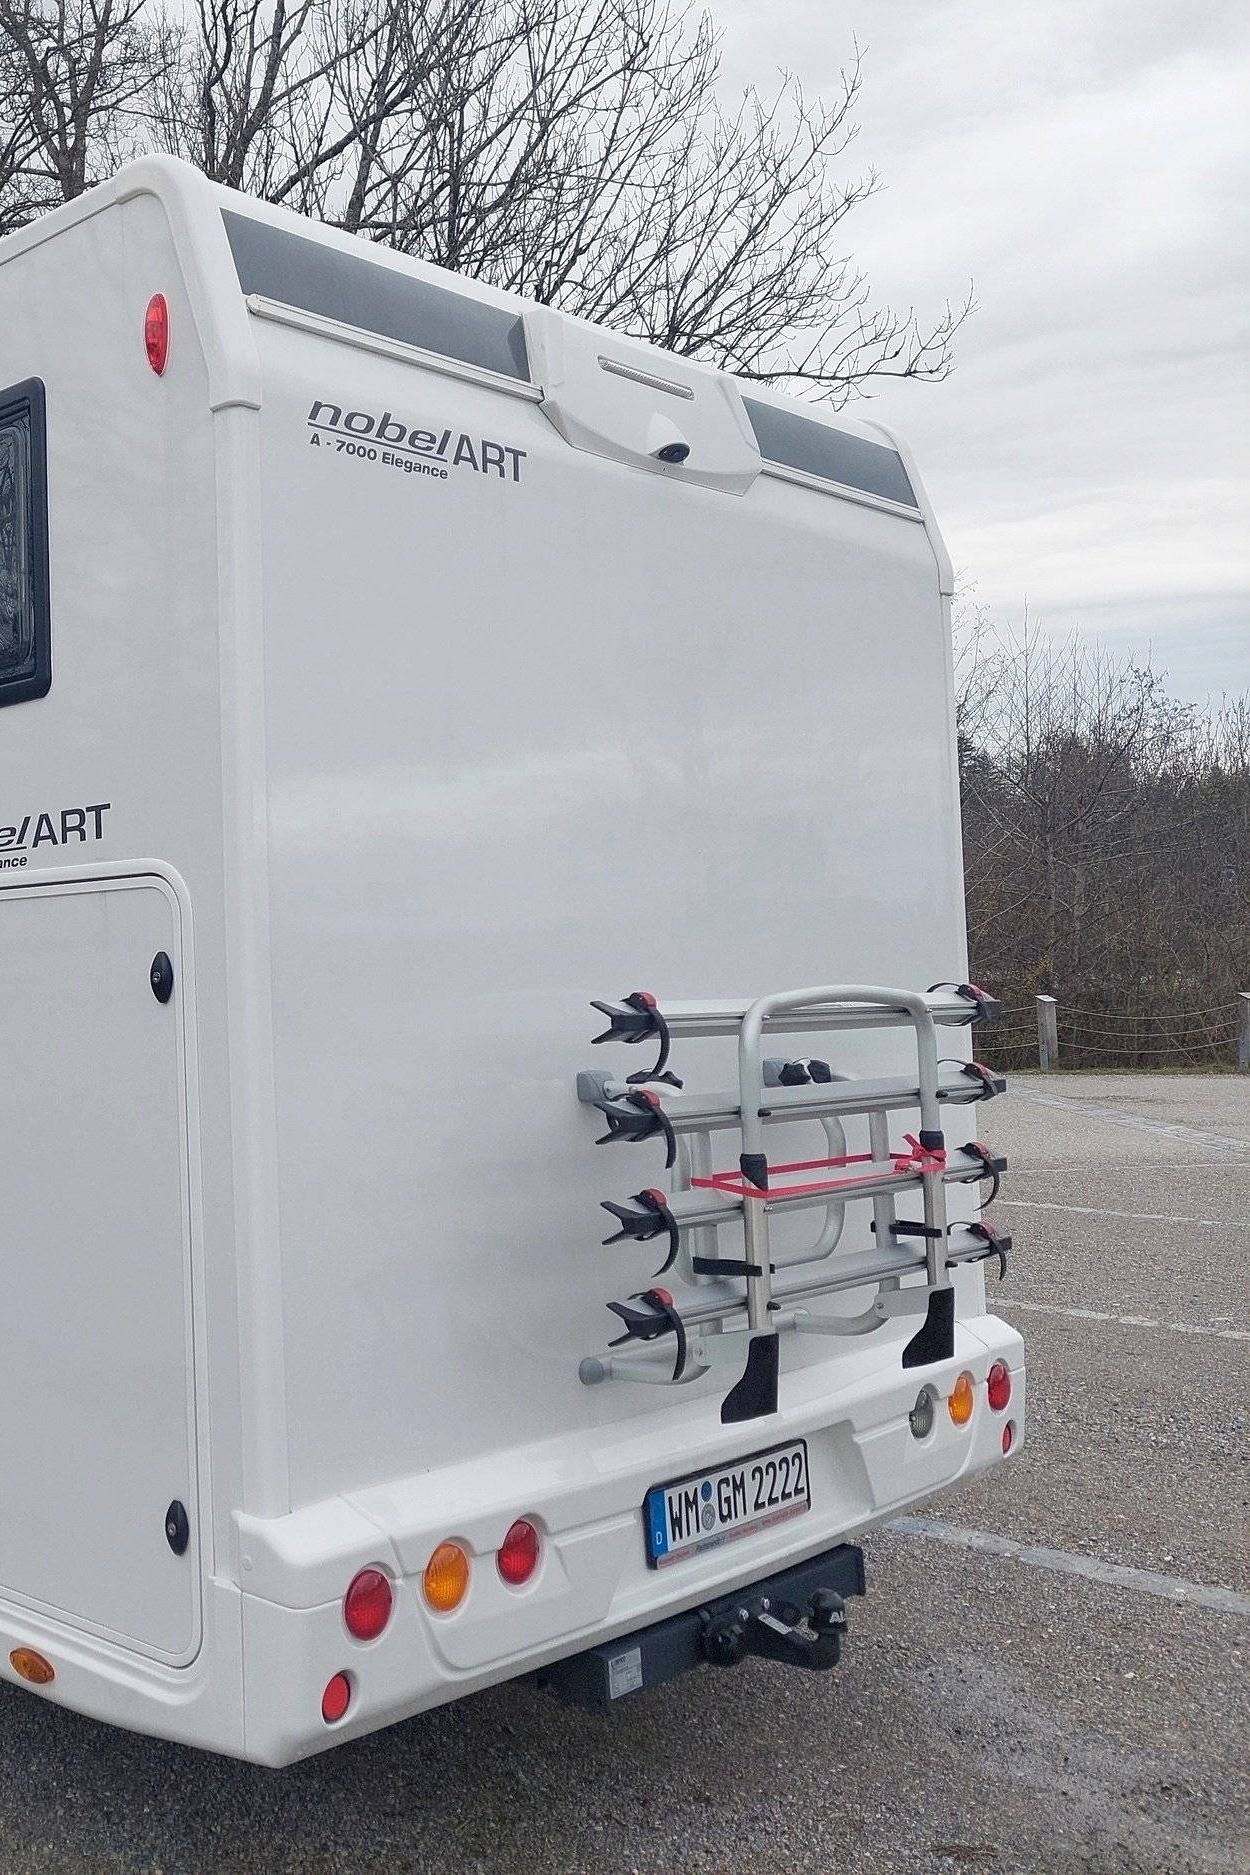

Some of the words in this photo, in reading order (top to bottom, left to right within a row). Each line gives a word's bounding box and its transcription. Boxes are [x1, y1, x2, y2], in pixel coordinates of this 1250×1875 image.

[309, 432, 321, 447] A
[335, 439, 378, 461] 7000
[381, 451, 449, 480] Elegance
[668, 1486, 701, 1542] WM
[716, 1470, 748, 1524] GM
[751, 1451, 806, 1512] 2222
[655, 1531, 663, 1546] D
